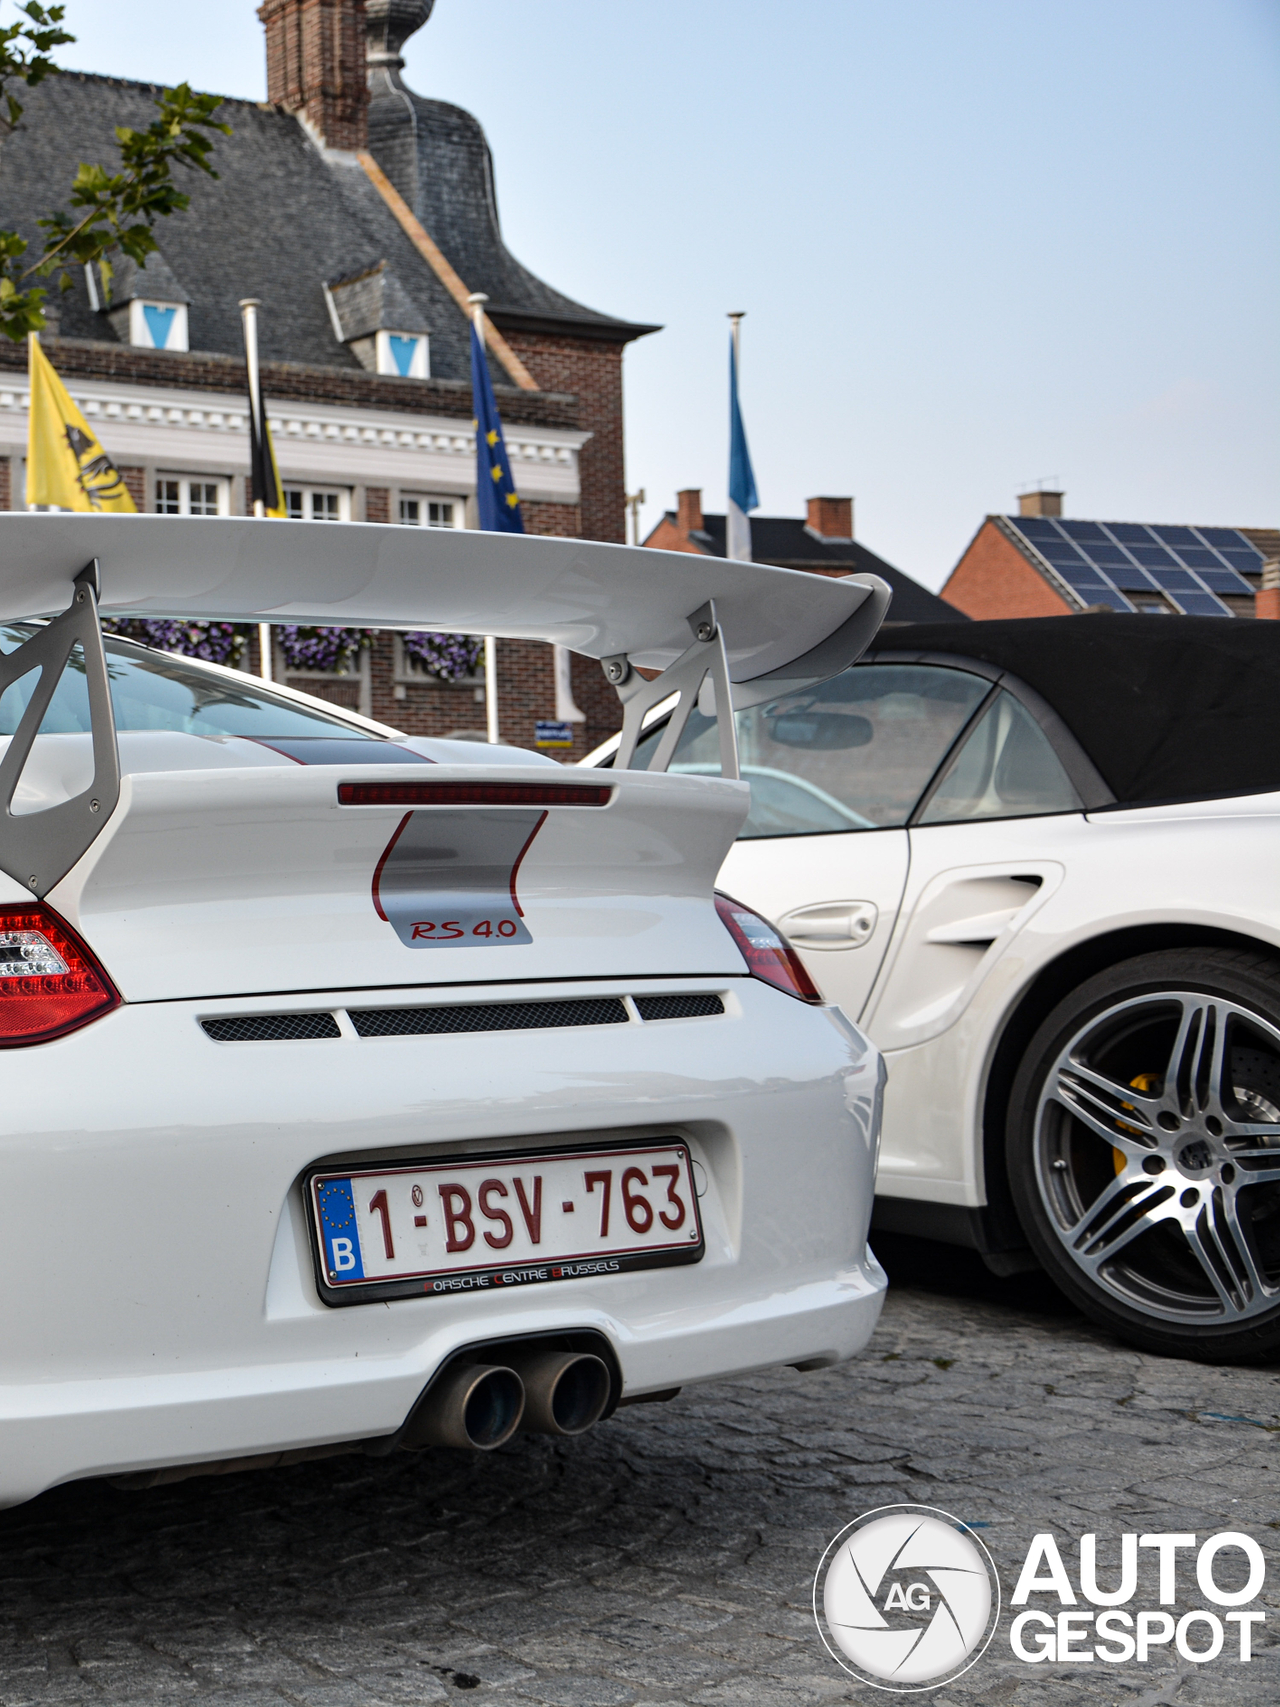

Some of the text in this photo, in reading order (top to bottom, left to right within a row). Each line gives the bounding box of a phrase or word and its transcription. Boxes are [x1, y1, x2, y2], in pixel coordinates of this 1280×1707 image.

[410, 919, 517, 940] RS 4.0
[331, 1237, 356, 1272] B
[423, 1260, 620, 1293] PORSCHE CENTRE BRUSSELS
